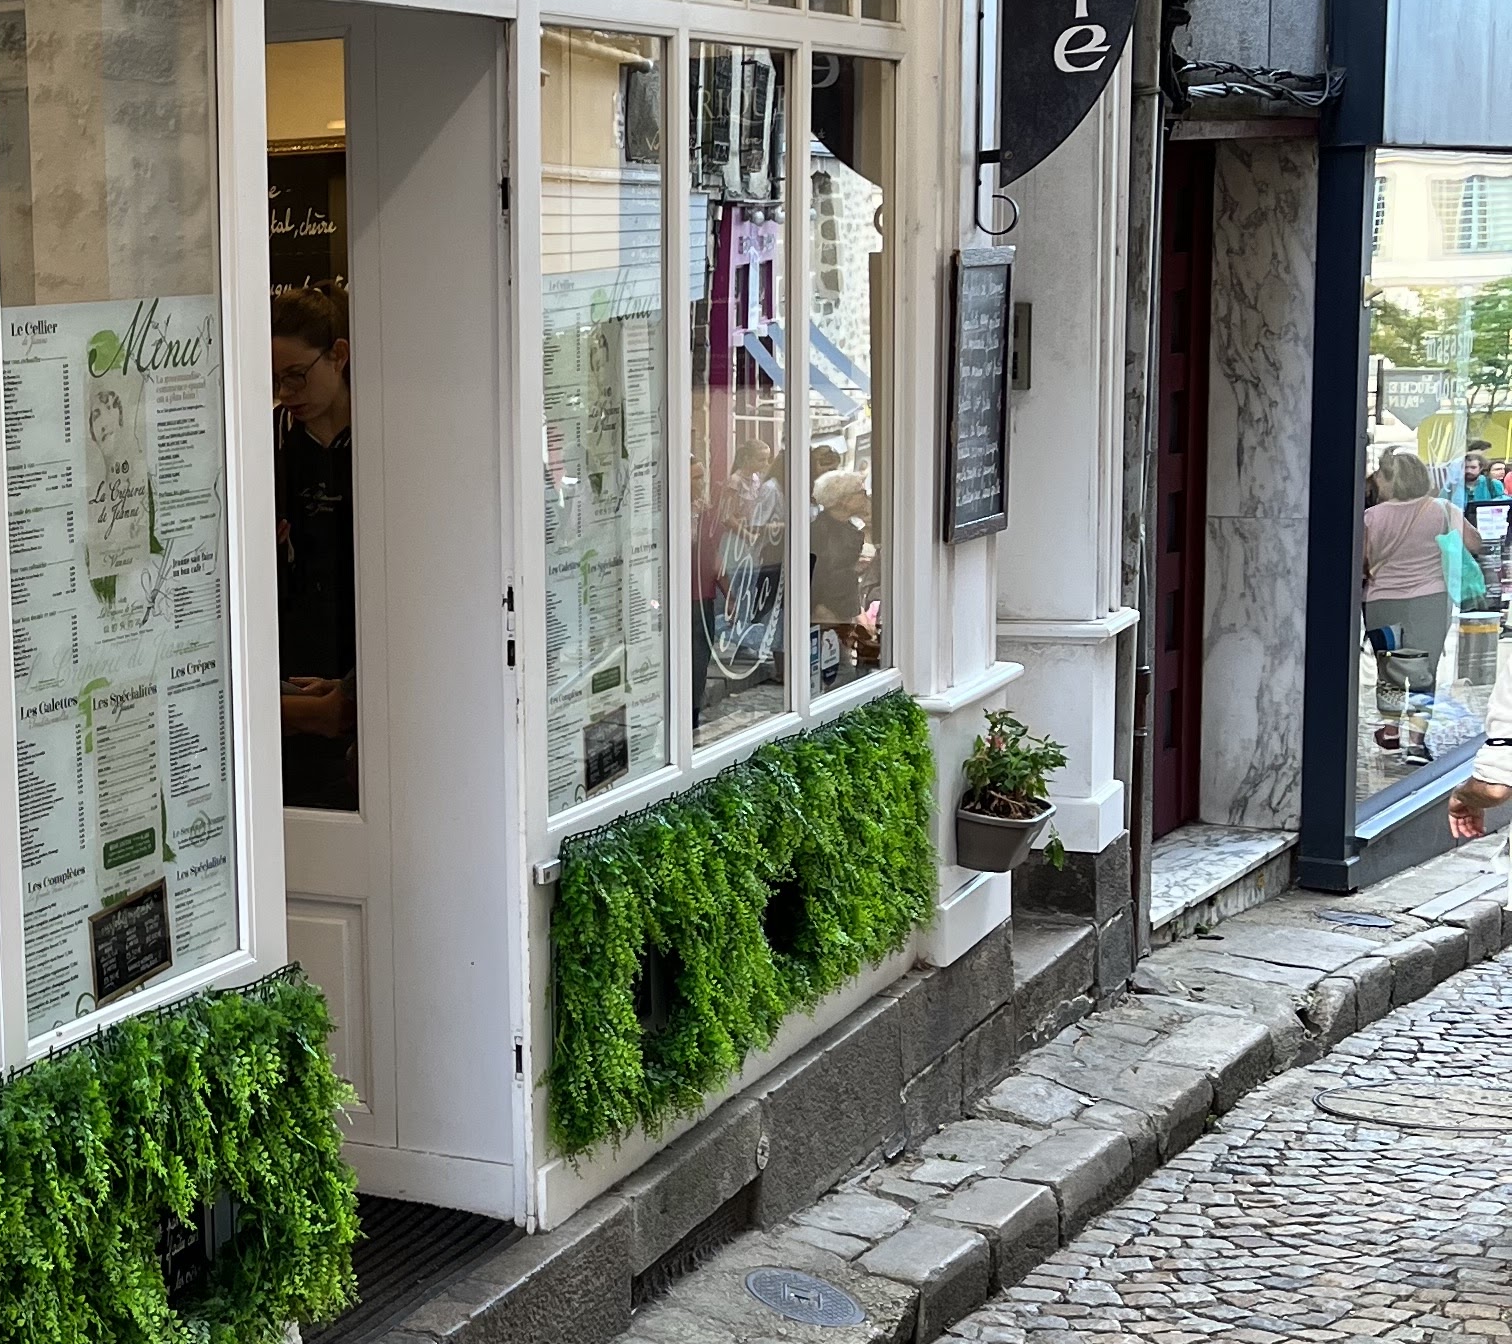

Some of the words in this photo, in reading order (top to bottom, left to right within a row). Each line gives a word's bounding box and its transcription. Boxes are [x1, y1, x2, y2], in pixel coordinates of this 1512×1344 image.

[24, 319, 58, 336] Cellier
[88, 297, 201, 379] Menu
[20, 705, 38, 721] Les
[38, 695, 78, 716] Galettes
[27, 878, 42, 895] Les
